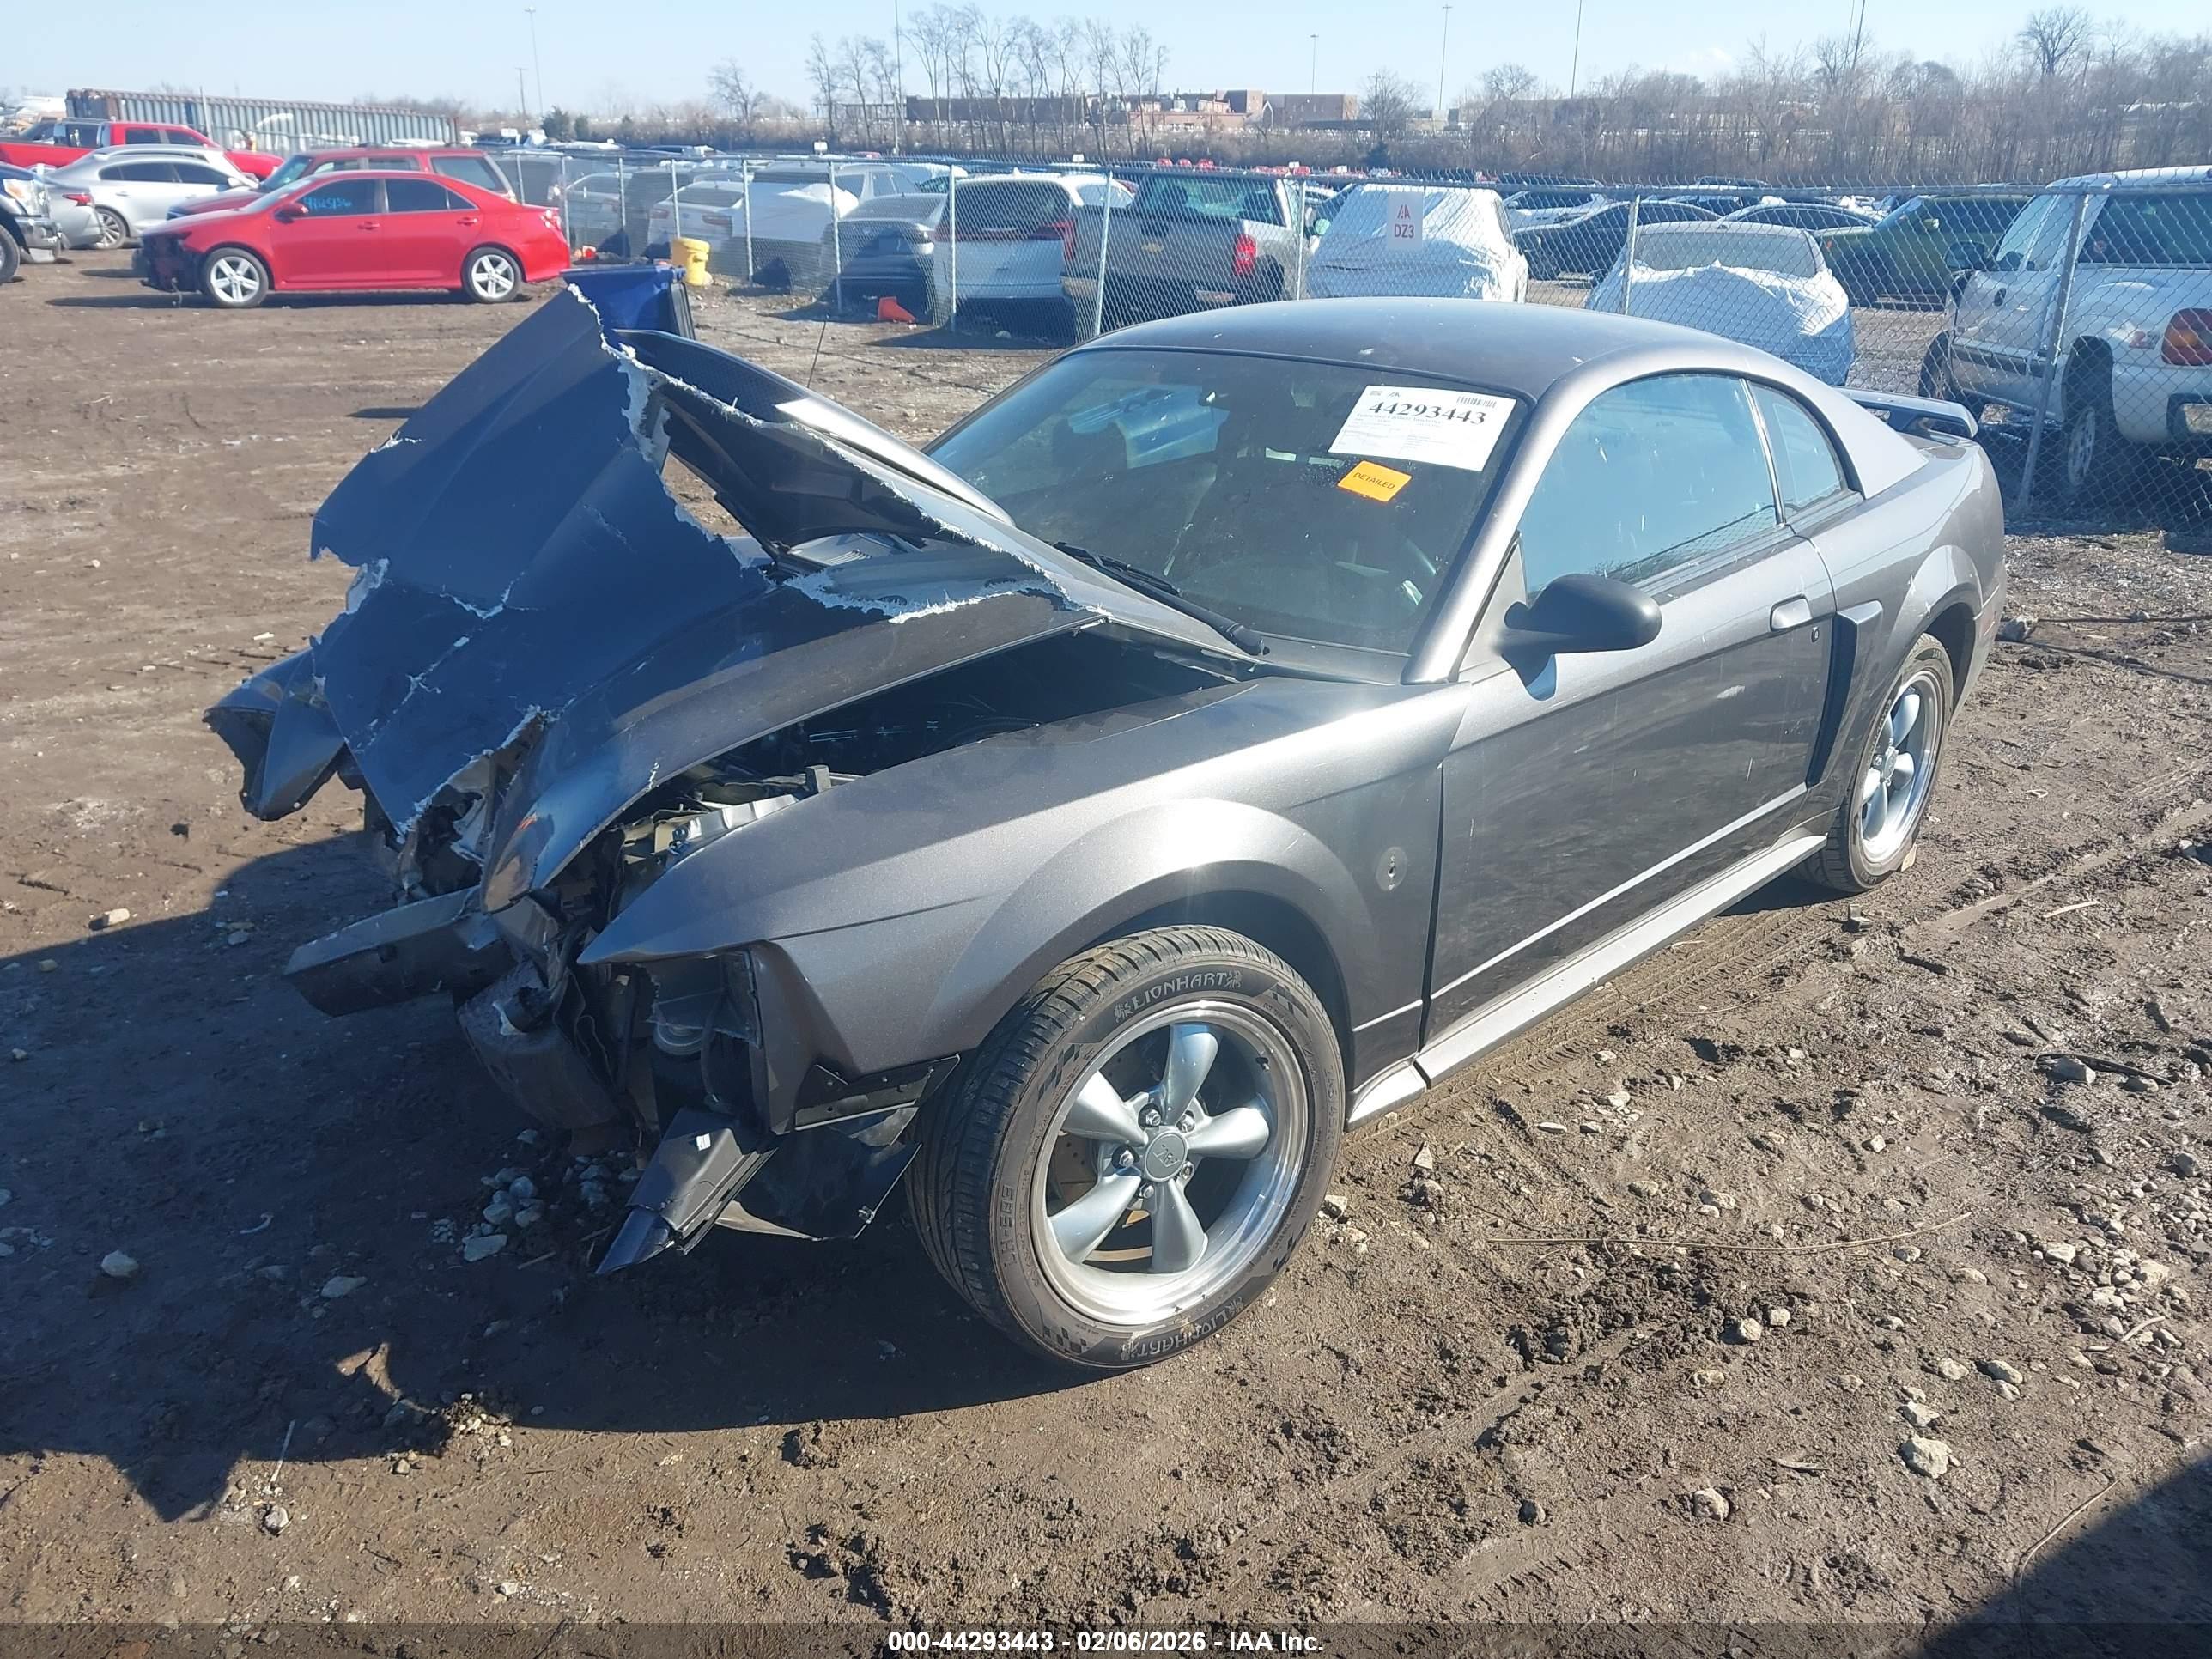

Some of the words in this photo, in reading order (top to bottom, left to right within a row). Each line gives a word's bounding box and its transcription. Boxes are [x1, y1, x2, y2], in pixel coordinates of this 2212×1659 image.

[1394, 223, 1415, 239] DZ3
[1368, 401, 1487, 425] 44293443
[1353, 471, 1395, 490] DETAILED
[1132, 971, 1227, 1011] LIONHART
[1137, 1307, 1227, 1357] LIONHART
